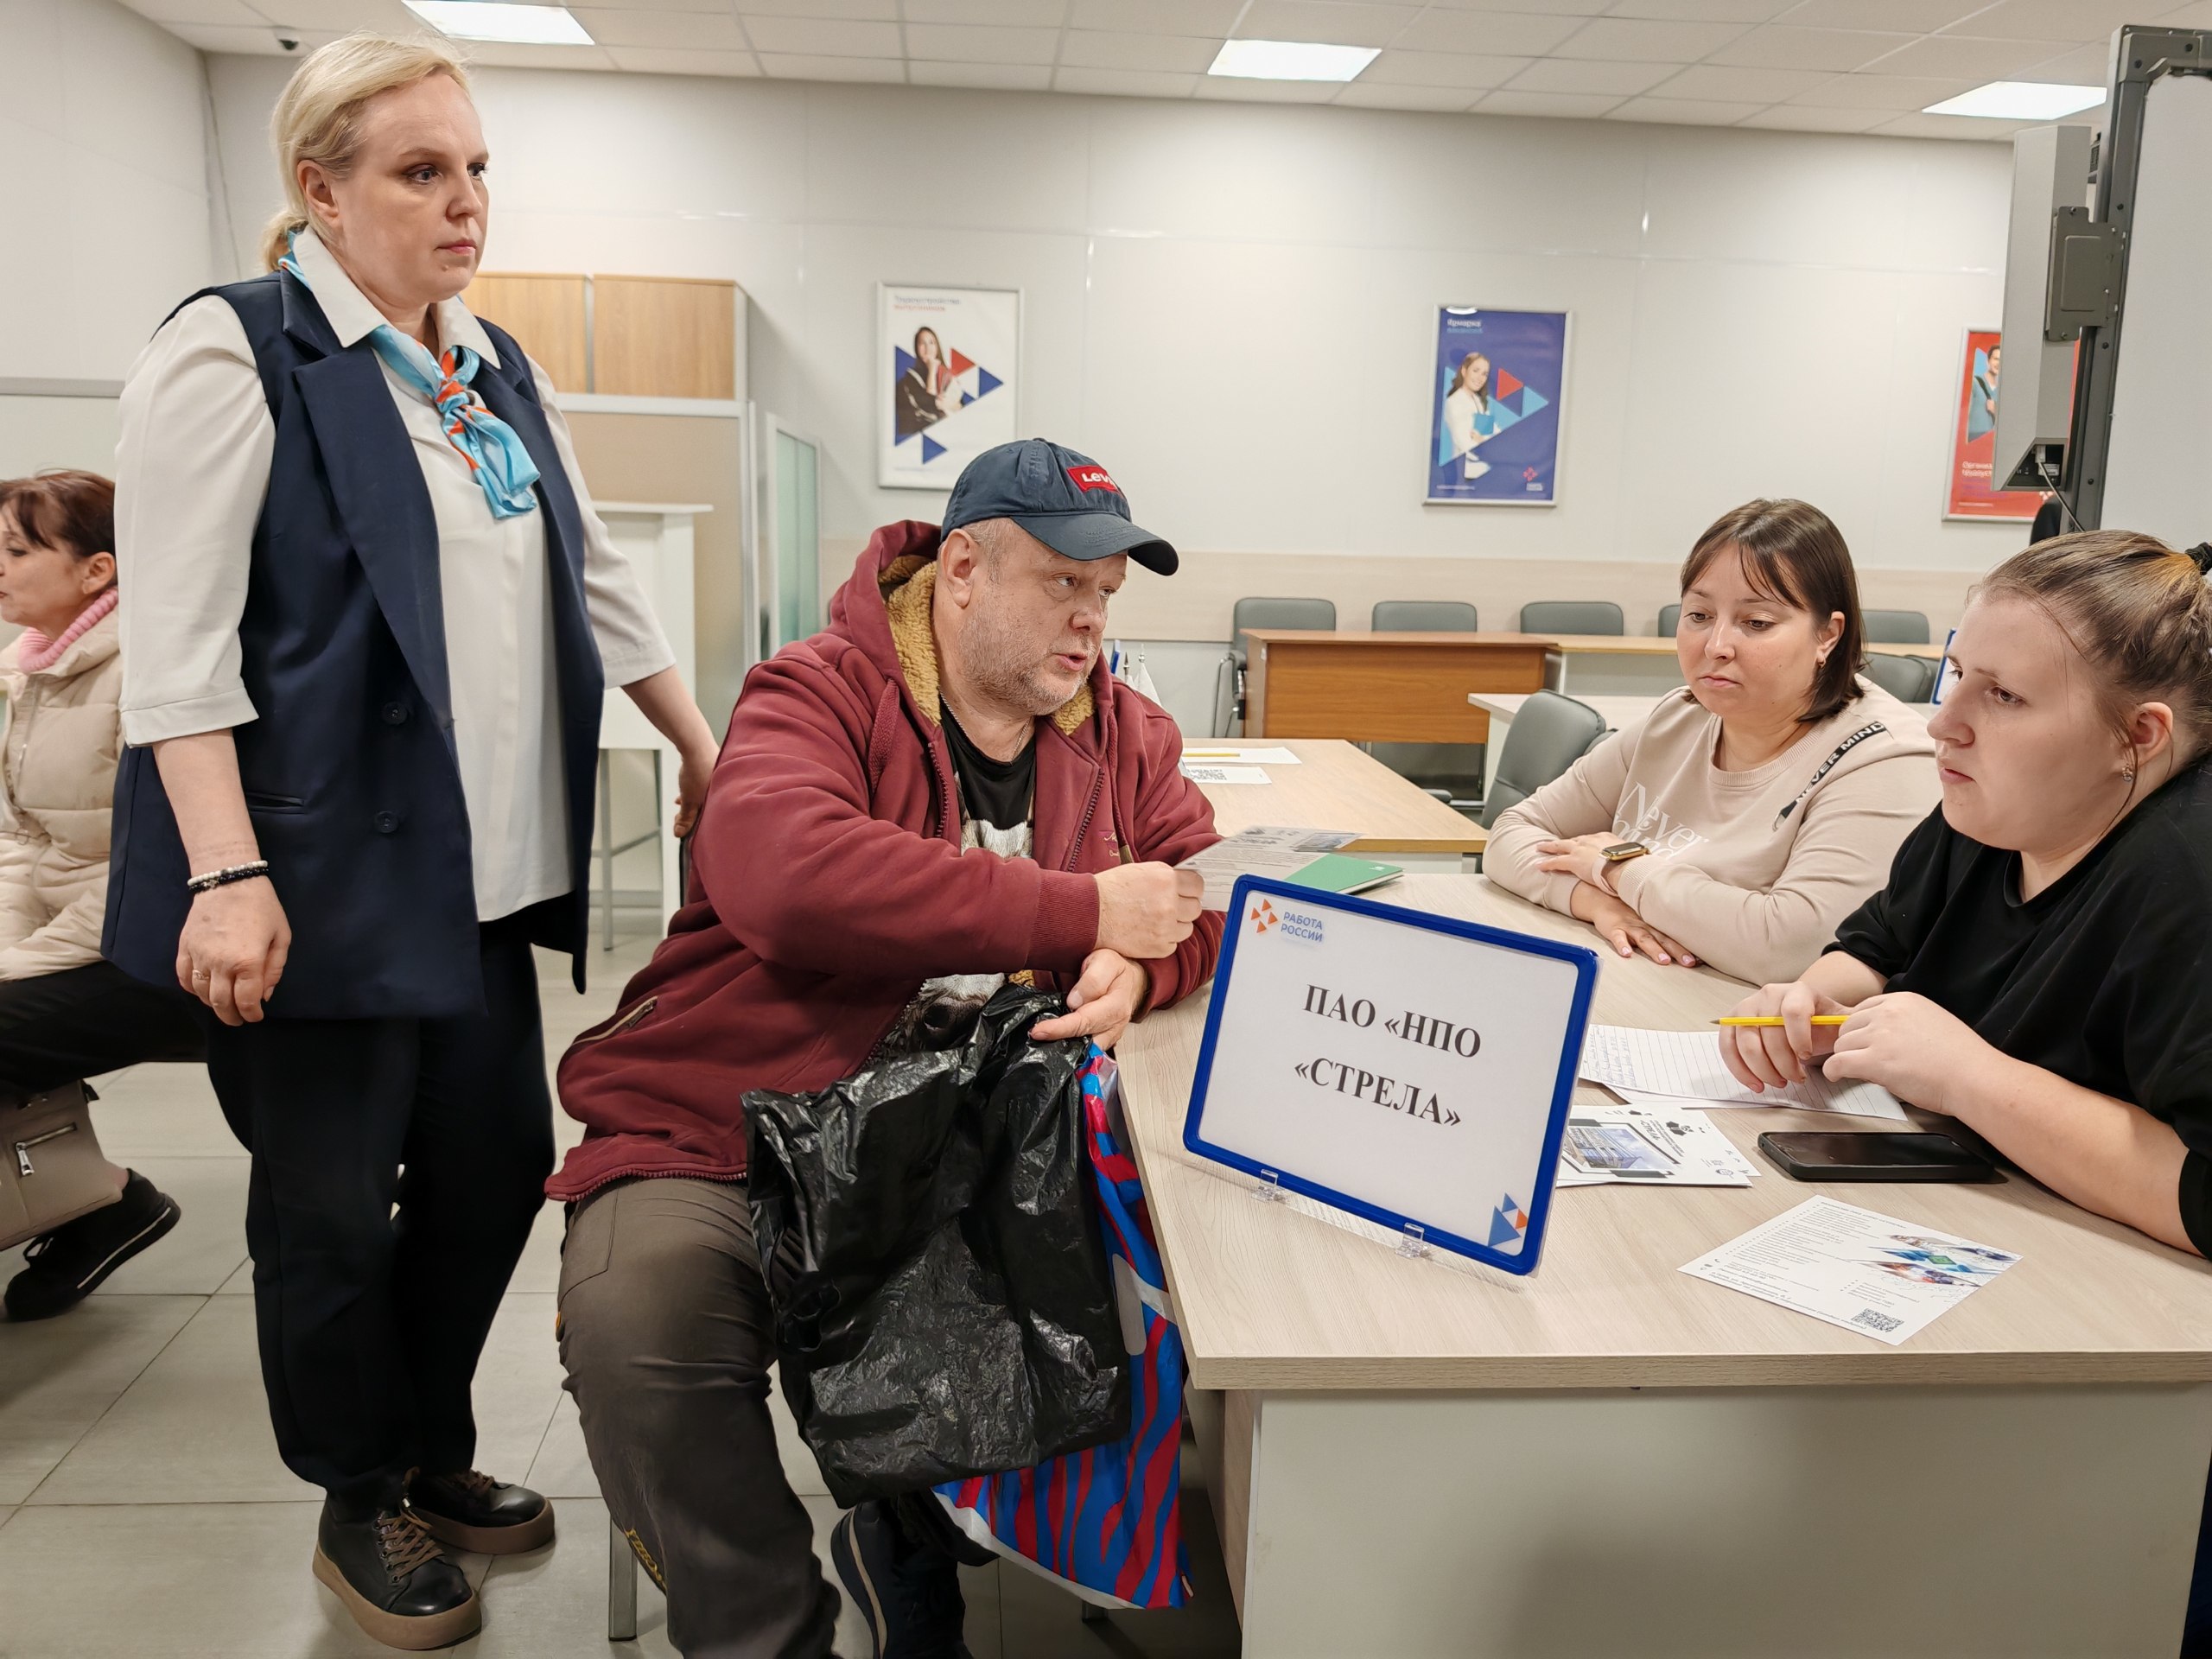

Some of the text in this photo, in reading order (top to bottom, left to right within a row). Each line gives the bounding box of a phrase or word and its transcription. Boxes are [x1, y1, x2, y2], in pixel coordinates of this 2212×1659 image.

[1840, 722, 1885, 750] MIND
[1281, 924, 1323, 943] РОССИИ
[1283, 912, 1323, 930] РАБОТА
[1302, 984, 1481, 1058] ПАО «НПО
[1294, 1058, 1462, 1126] «СТРЕЛА»
